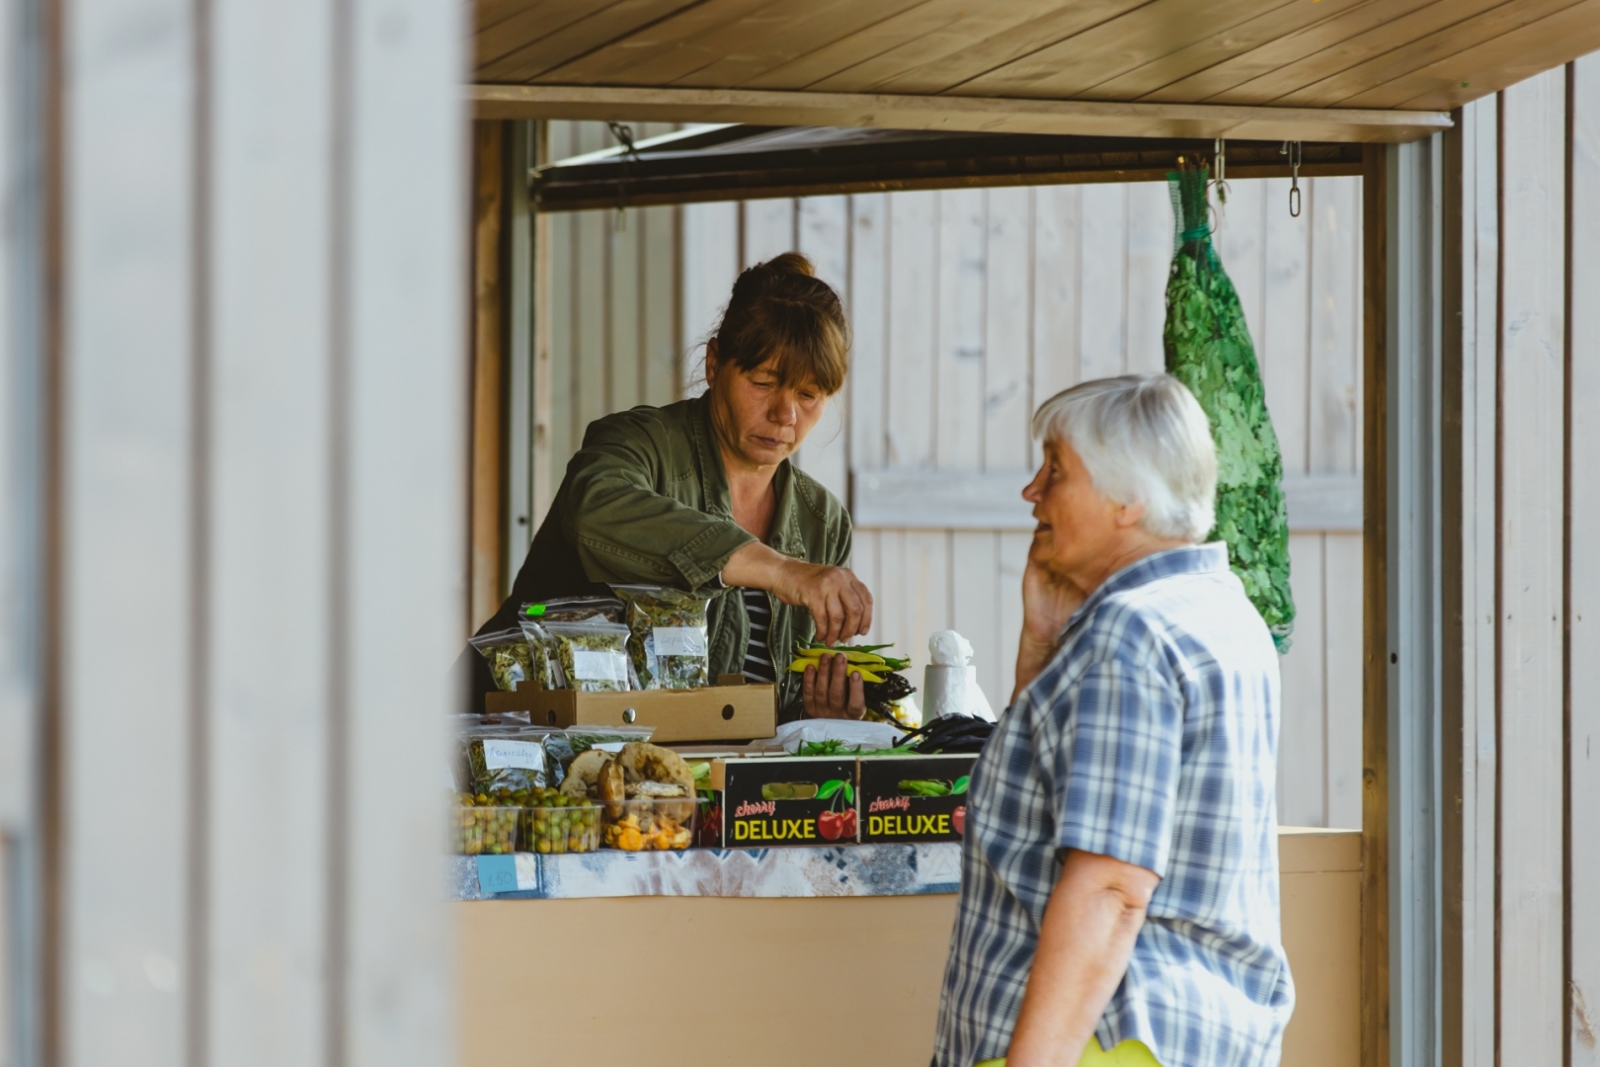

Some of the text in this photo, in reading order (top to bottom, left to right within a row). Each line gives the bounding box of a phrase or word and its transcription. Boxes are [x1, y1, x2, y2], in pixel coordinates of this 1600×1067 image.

[734, 800, 776, 817] cherry
[869, 796, 910, 812] cherry
[735, 819, 816, 840] DELUXE
[868, 814, 950, 835] DELUXE
[487, 871, 513, 888] 1.50
